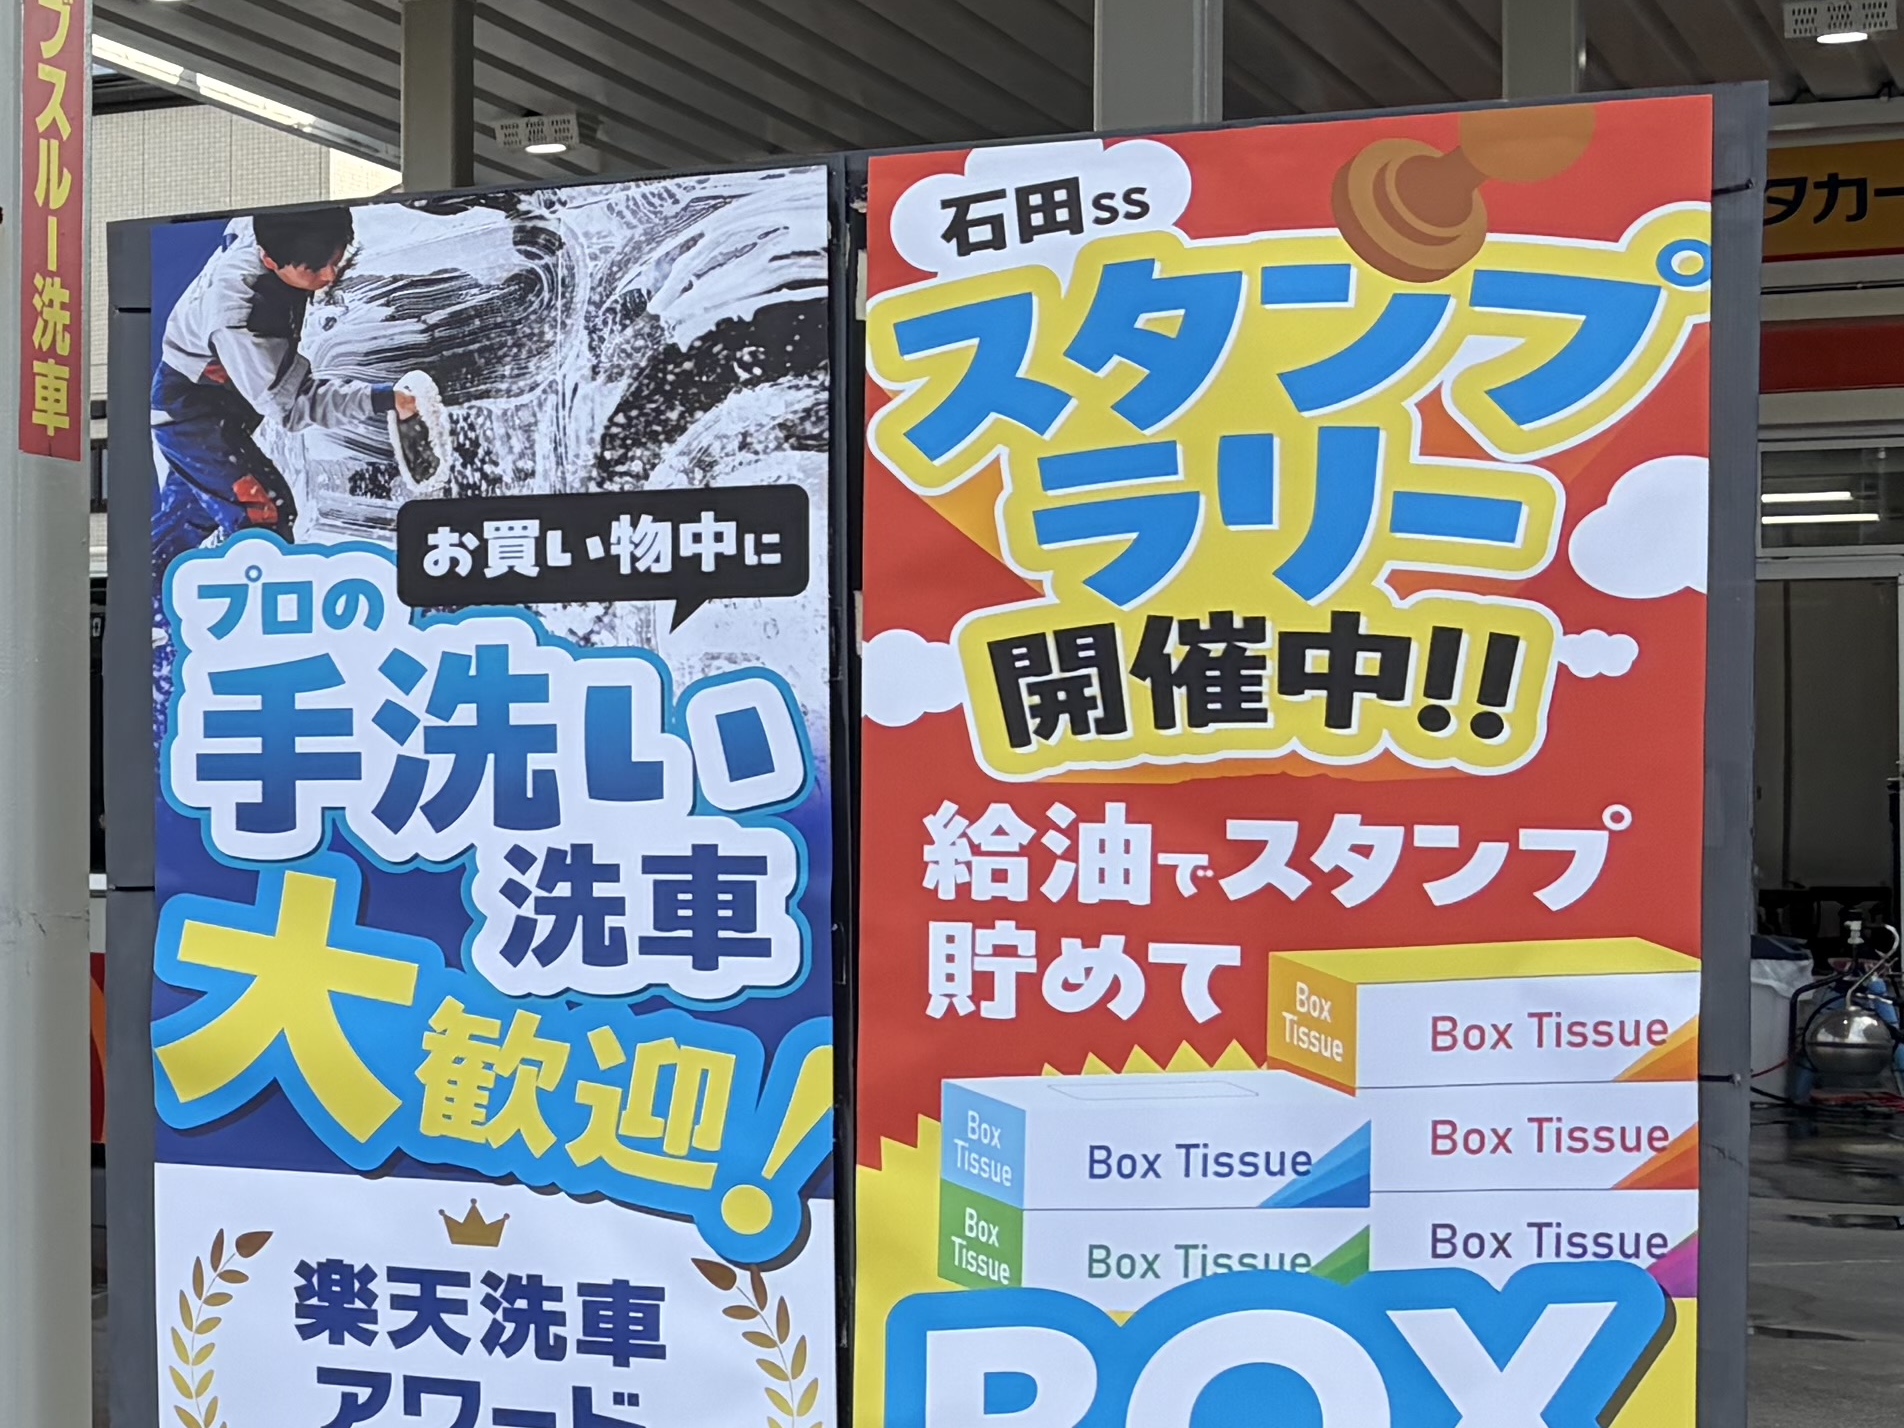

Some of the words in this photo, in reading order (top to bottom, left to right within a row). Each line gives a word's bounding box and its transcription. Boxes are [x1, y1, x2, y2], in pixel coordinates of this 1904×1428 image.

[892, 238, 1711, 462] スタンプ
[422, 510, 782, 579] お買い物中に
[1032, 425, 1524, 608] ラリー
[196, 564, 385, 640] プロの
[986, 609, 1522, 749] 開催中!!
[195, 643, 776, 835] 手洗い
[921, 798, 1633, 912] 給油でスタンプ
[498, 843, 772, 971] 洗車
[926, 919, 1243, 1024] 貯めて
[1294, 979, 1333, 1024] Box
[154, 870, 834, 1236] 大歓迎!
[1281, 1009, 1346, 1064] Tissue
[1430, 1014, 1514, 1053] Box
[1527, 1011, 1670, 1049] Tissue
[965, 1110, 1003, 1150] Box
[1430, 1119, 1514, 1157] Box
[1527, 1117, 1670, 1154] Tissue
[952, 1138, 1014, 1189] Tissue
[1088, 1145, 1162, 1181] Box
[1176, 1143, 1313, 1178] Tissue
[963, 1207, 1000, 1248] Box
[1429, 1224, 1513, 1260] Box
[1527, 1223, 1670, 1261] Tissue
[950, 1237, 1011, 1285] Tissue
[1086, 1244, 1161, 1280] Box
[1175, 1245, 1313, 1274] Tissue
[293, 1258, 668, 1368] 楽天洗車
